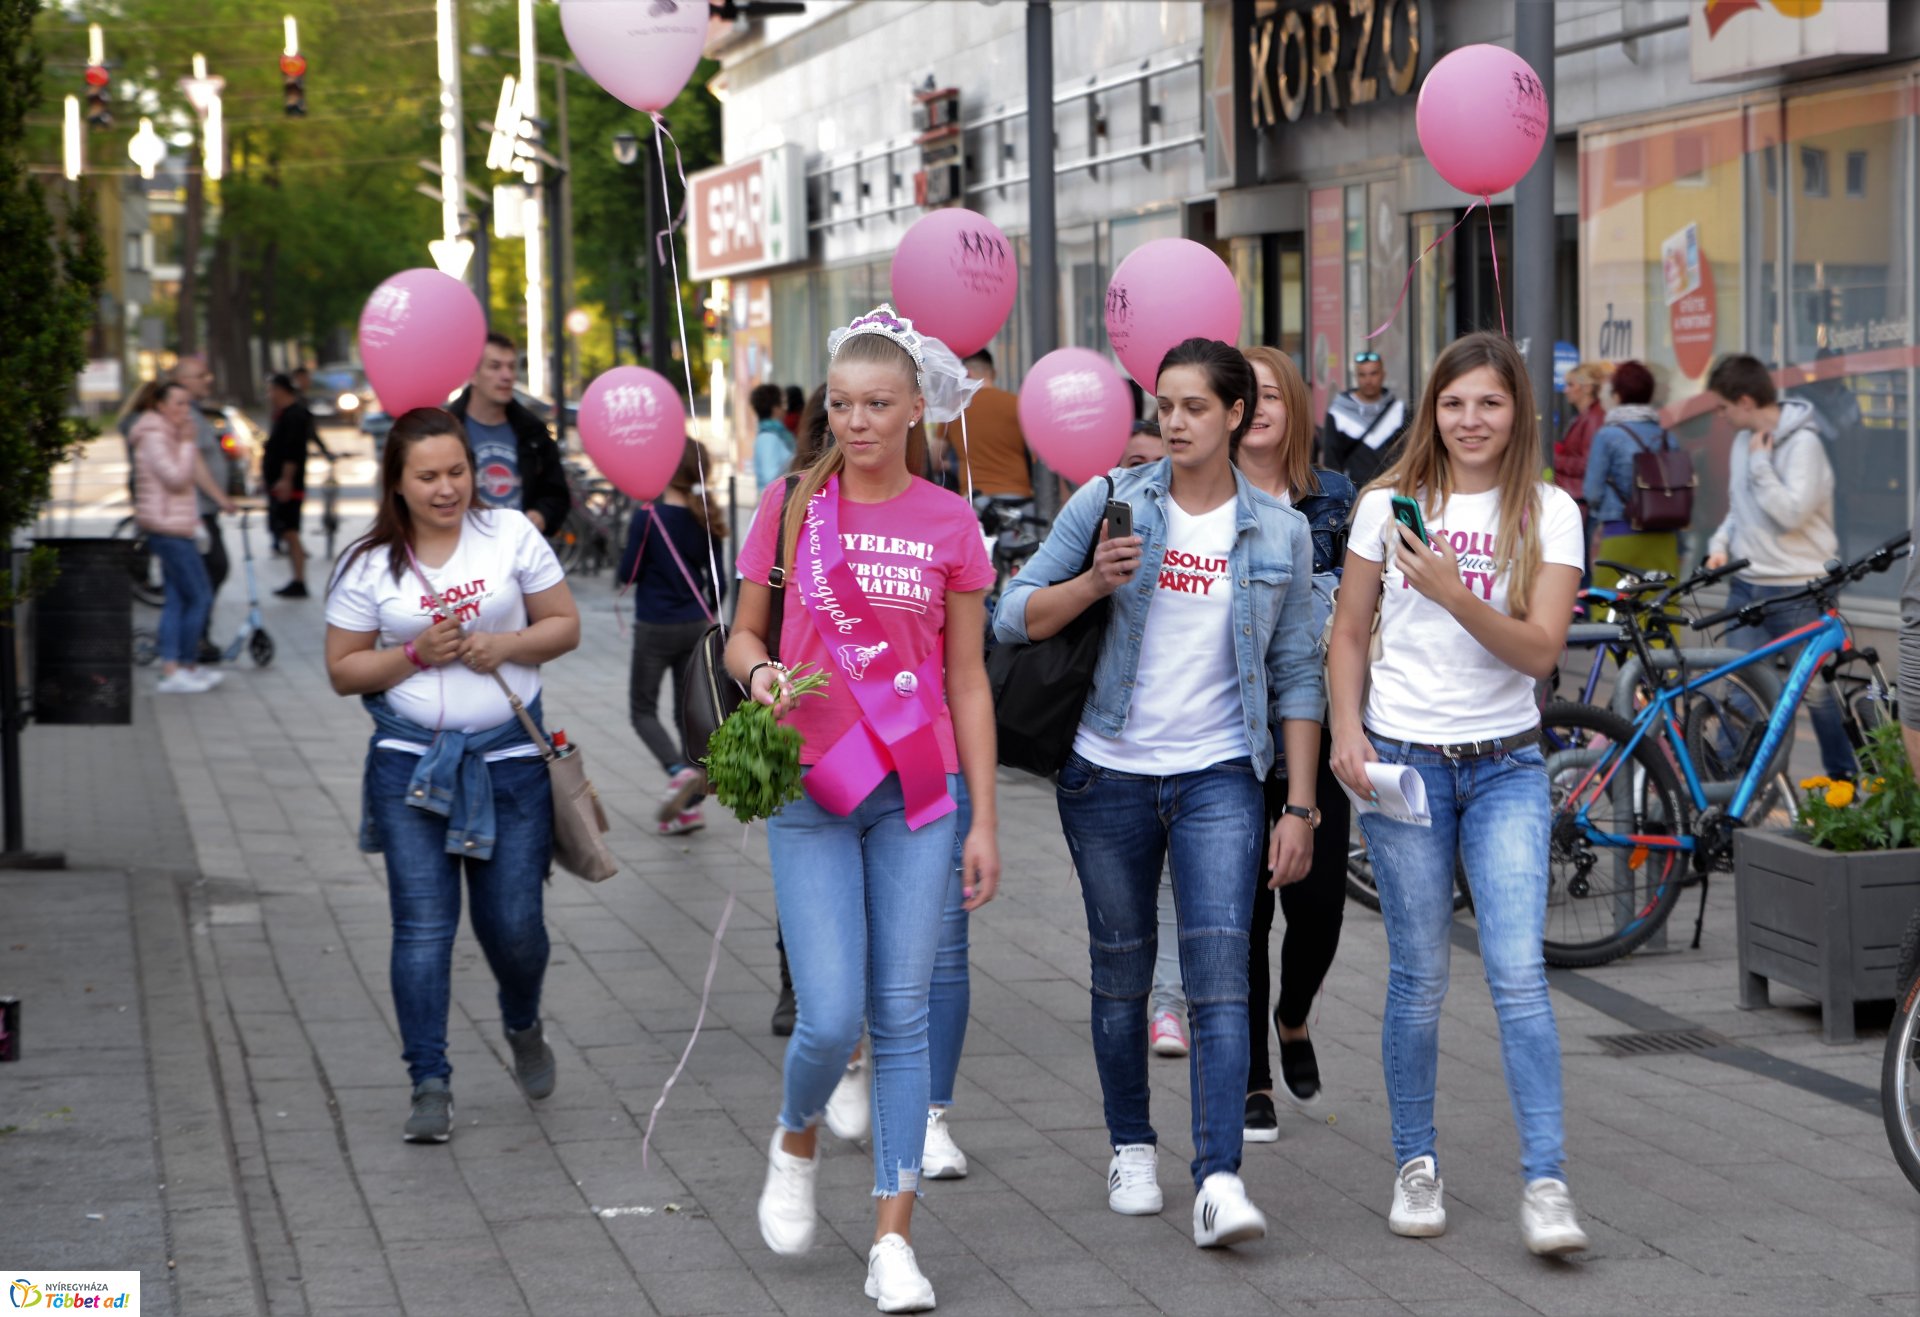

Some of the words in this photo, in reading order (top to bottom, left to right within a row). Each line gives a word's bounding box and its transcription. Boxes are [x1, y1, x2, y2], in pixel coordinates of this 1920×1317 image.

[708, 174, 762, 257] SPAR
[1599, 302, 1633, 360] dm
[838, 532, 934, 562] YELEM!
[1162, 548, 1228, 574] SOLUT
[848, 562, 922, 583] YBÚCSÚ
[810, 558, 862, 635] megyek
[855, 576, 932, 603] MATBAN
[432, 600, 481, 626] PRTY
